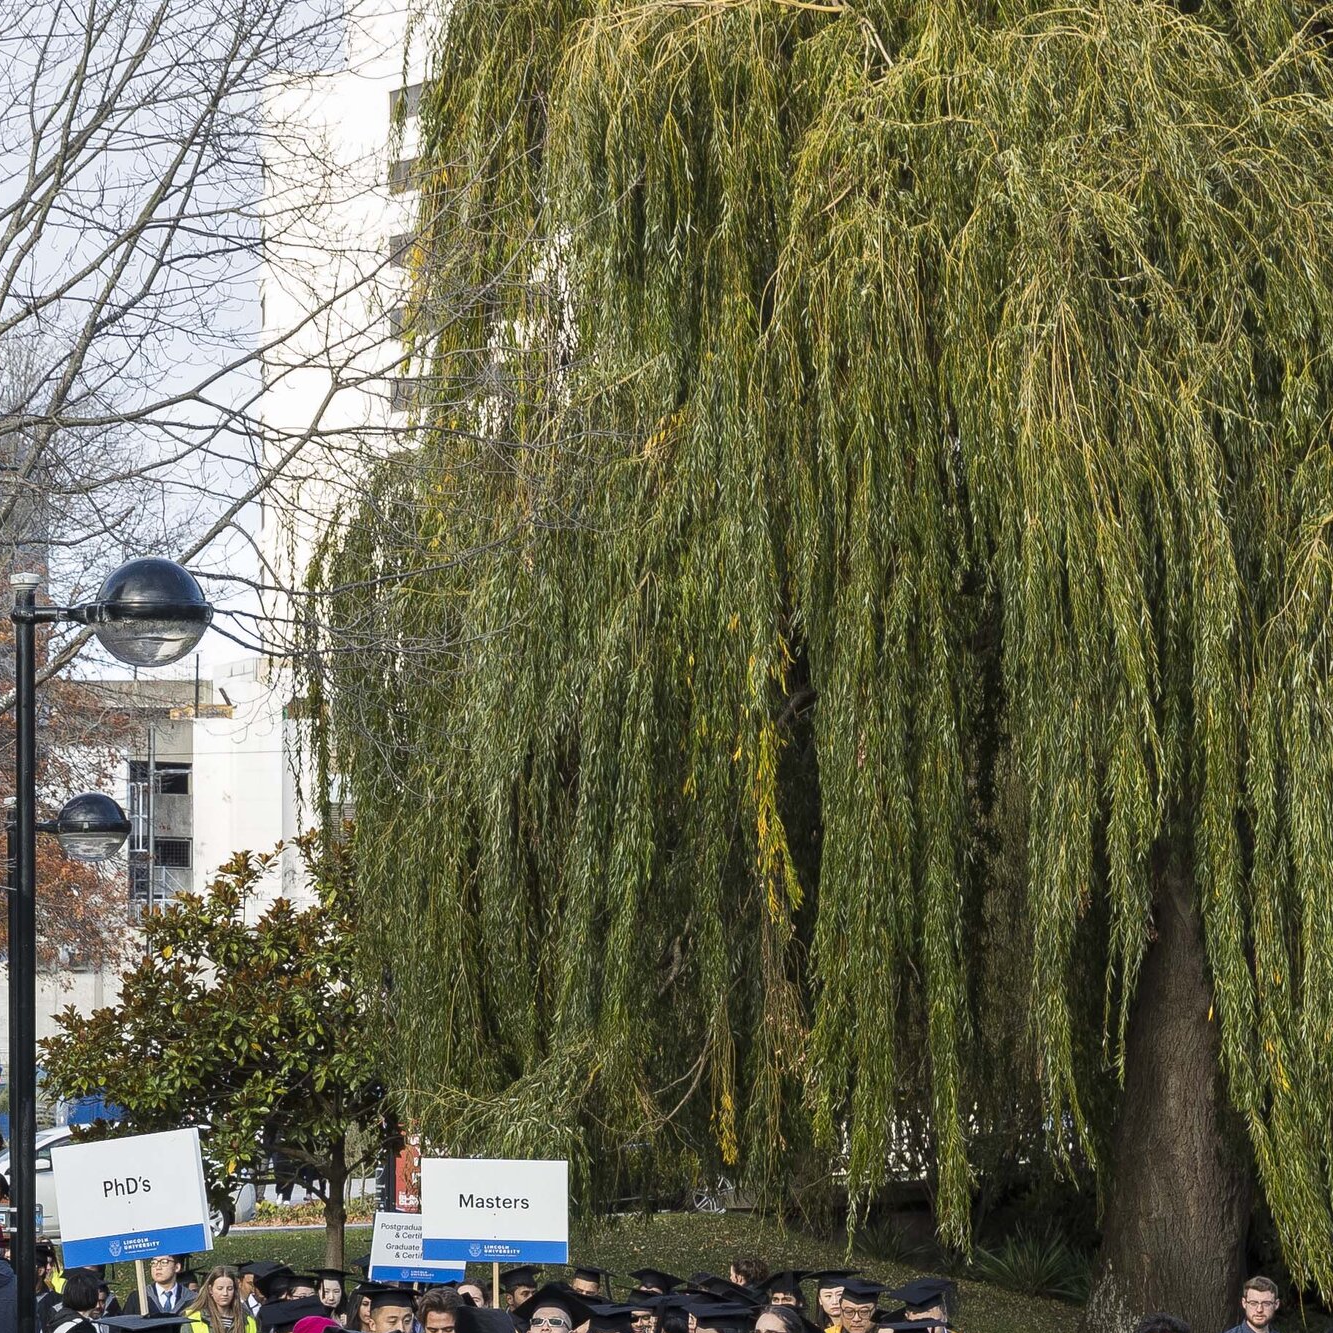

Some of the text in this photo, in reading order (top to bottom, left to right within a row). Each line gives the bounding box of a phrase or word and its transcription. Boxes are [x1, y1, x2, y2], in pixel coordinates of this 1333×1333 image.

[103, 1176, 151, 1198] PhD's
[459, 1193, 529, 1209] Masters
[394, 1231, 400, 1239] &
[123, 1237, 149, 1245] LINCOLN
[123, 1241, 160, 1250] UNIVERSITY
[385, 1242, 420, 1251] Graduate
[394, 1251, 400, 1259] &
